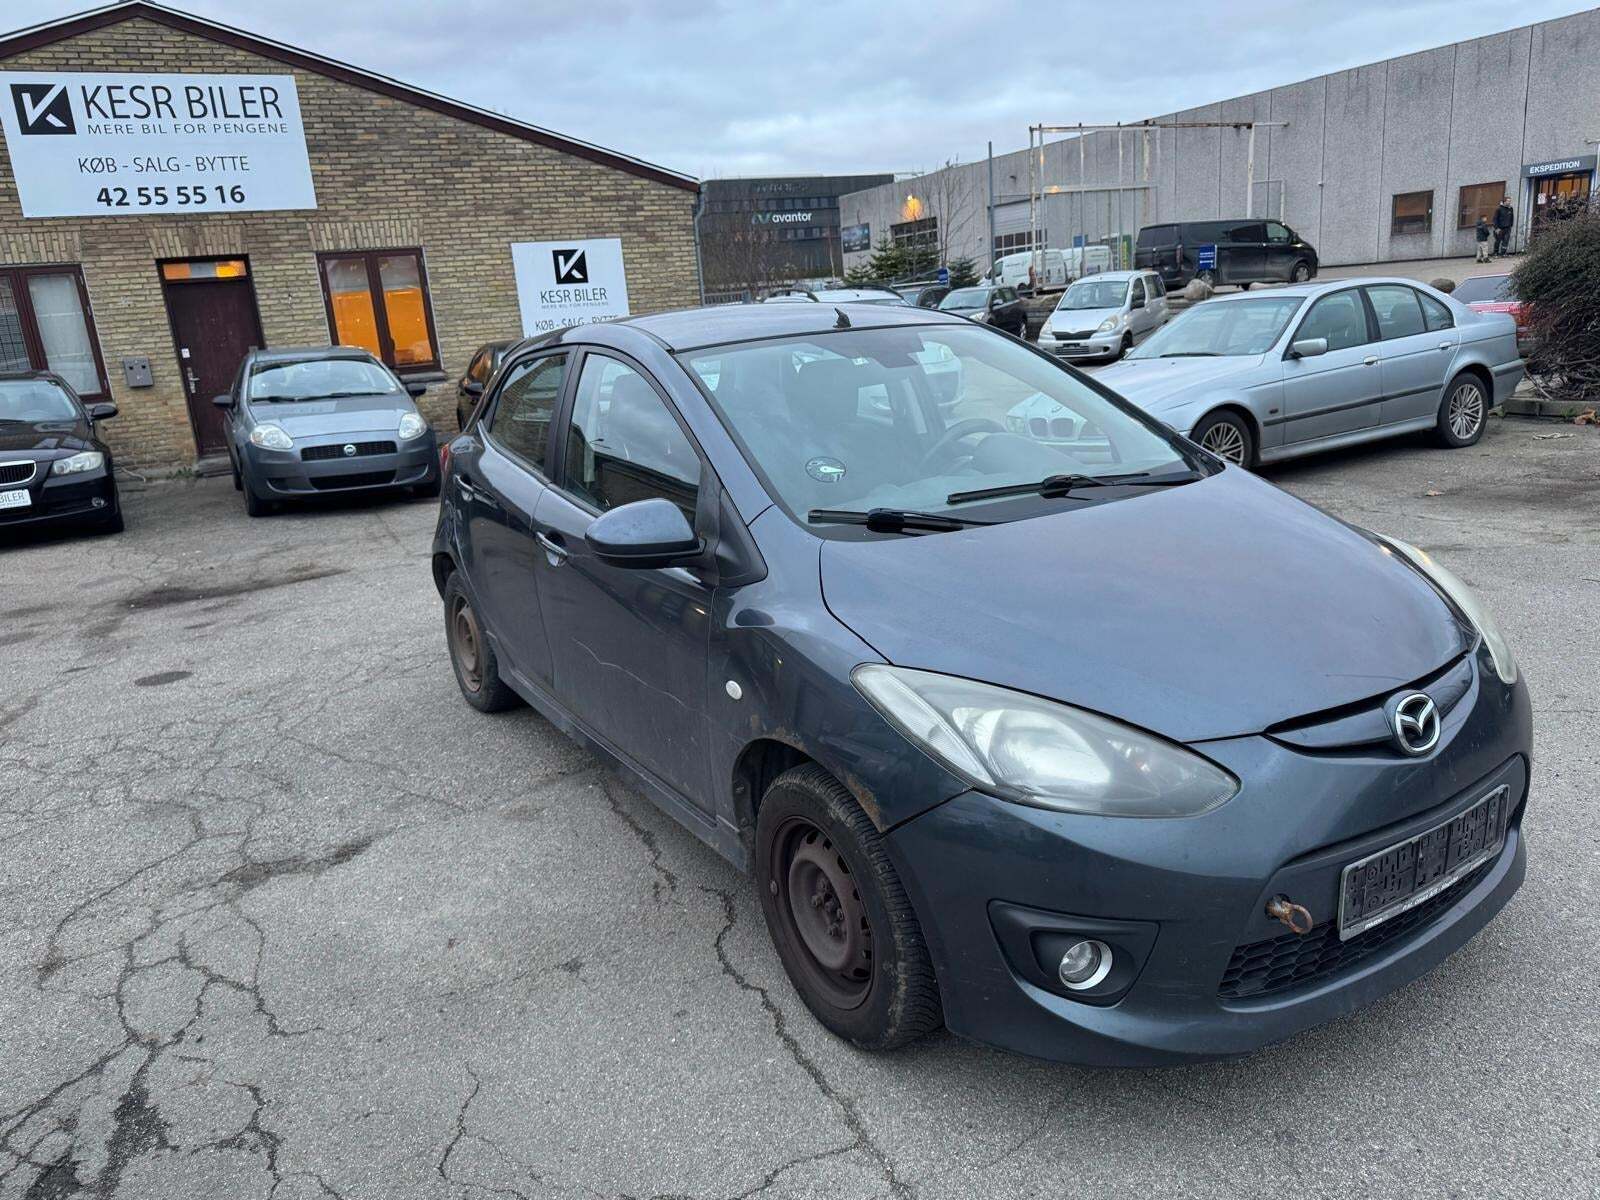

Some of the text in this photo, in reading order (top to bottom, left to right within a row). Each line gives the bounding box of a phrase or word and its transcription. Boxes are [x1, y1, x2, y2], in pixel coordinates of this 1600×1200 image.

[81, 85, 283, 119] KESR BILER
[87, 123, 289, 135] MERE BIL FOR PENGENE
[78, 157, 118, 174] KØB
[133, 156, 180, 173] SALG
[195, 155, 250, 172] BYTTE
[1529, 160, 1580, 174] EKSPEDITION
[96, 184, 246, 207] 42 55 55 16
[772, 212, 812, 223] avantor
[540, 287, 608, 304] KESR BILER
[535, 319, 555, 331] KØB
[561, 316, 585, 329] SALG
